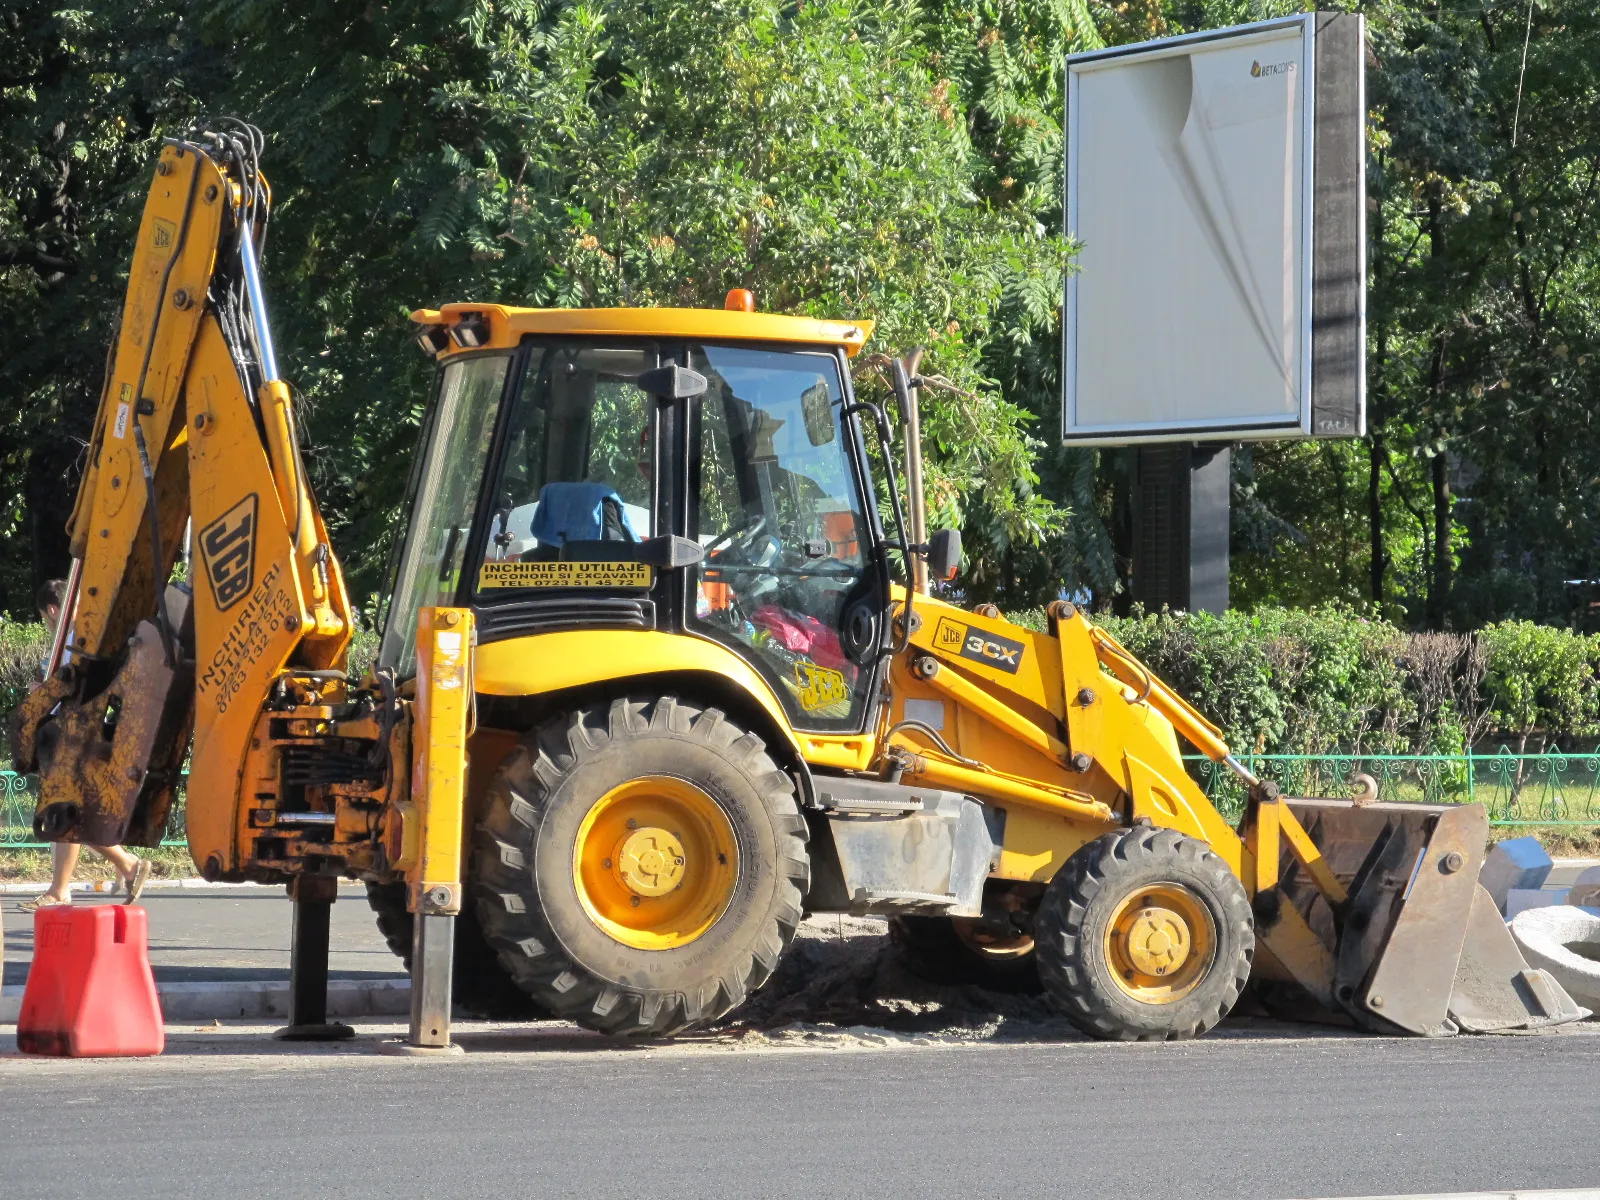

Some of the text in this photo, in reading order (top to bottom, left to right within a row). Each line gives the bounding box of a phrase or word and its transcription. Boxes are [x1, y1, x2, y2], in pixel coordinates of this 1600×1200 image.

[154, 226, 171, 247] JCB
[205, 513, 252, 604] JCB
[484, 563, 646, 572] INCHIRIERI UTILAJE
[263, 588, 287, 622] 572
[198, 563, 280, 693] INCHIRIERI
[213, 591, 275, 687] UTILAJE
[942, 626, 1019, 665] JCB 3CX
[218, 597, 293, 714] 0763 132 012
[803, 667, 845, 704] JCB
